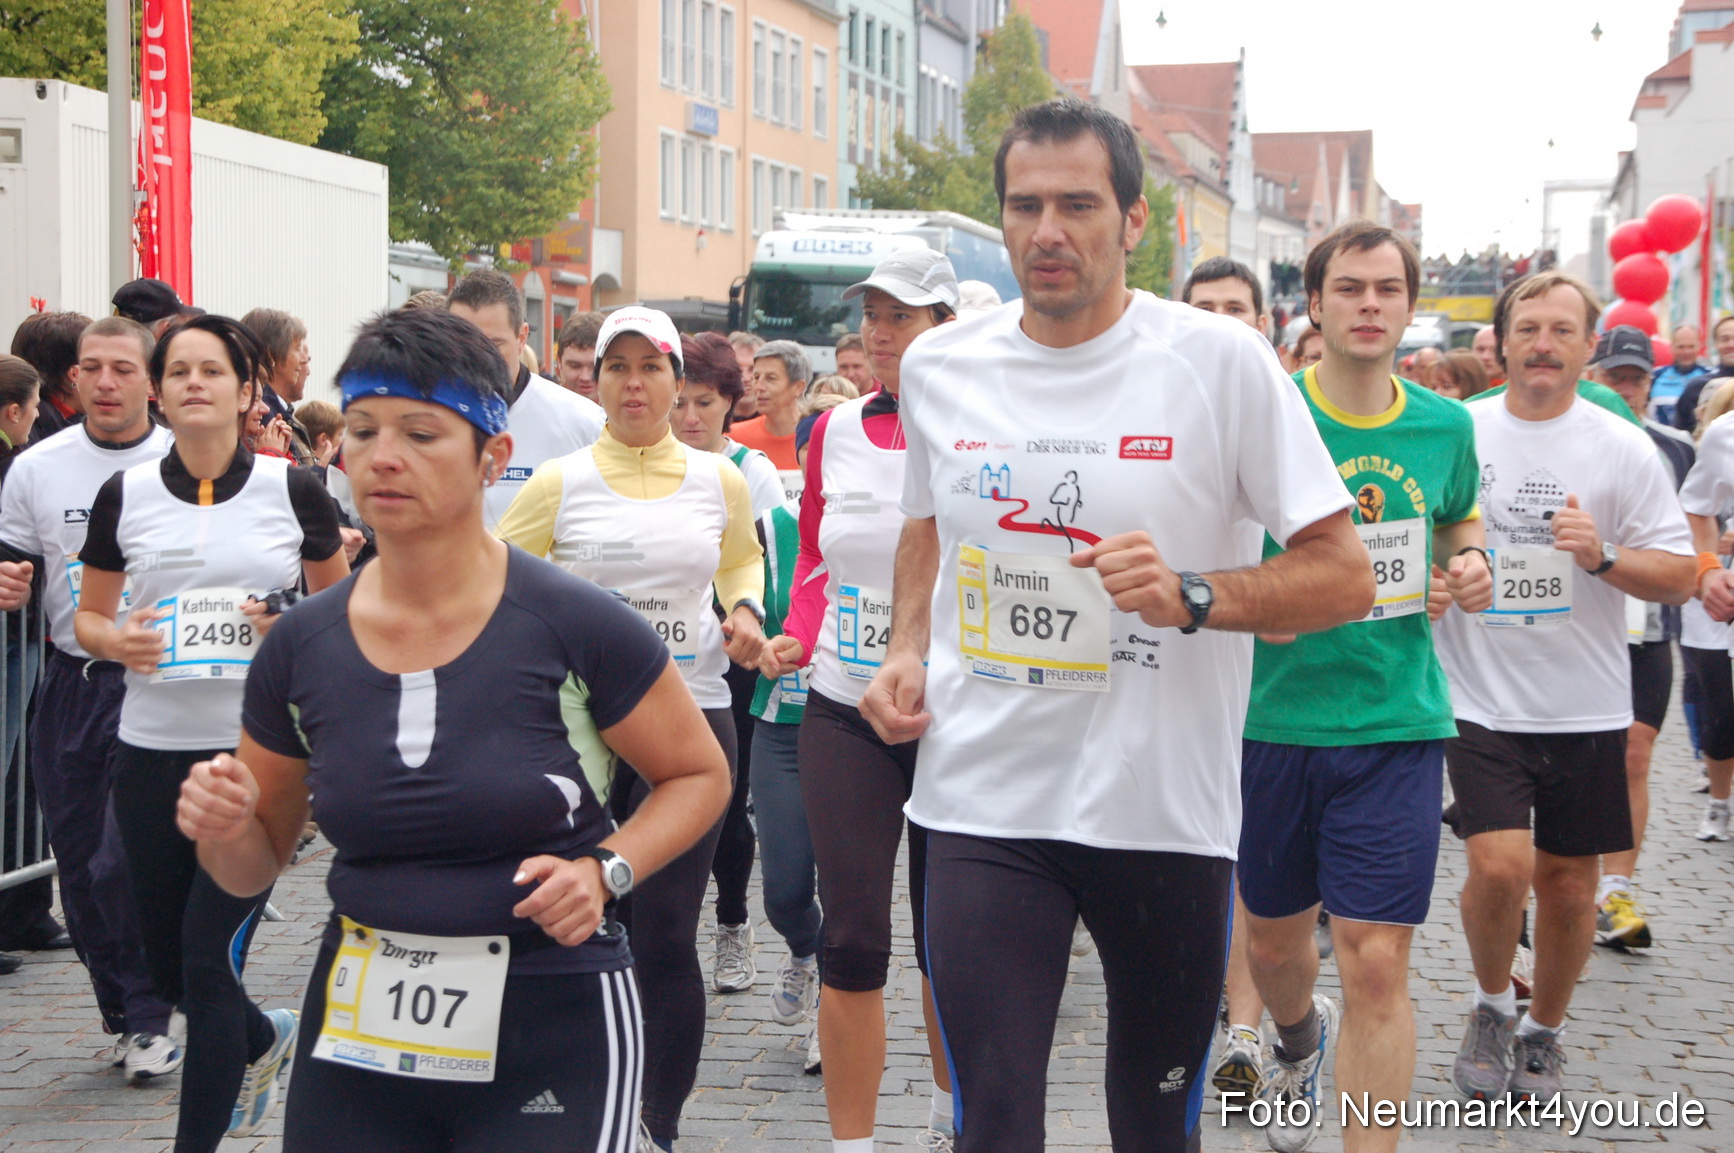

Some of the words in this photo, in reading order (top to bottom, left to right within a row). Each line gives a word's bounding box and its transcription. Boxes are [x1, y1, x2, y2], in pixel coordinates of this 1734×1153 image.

[793, 239, 872, 254] BOCK
[1337, 456, 1404, 481] WORLD
[1402, 477, 1426, 515] CUP
[1493, 523, 1551, 534] Neumarkt
[1501, 556, 1526, 569] Uwe
[994, 564, 1049, 592] Armin
[1503, 577, 1562, 599] 2058
[182, 598, 233, 615] Kathrin
[649, 621, 686, 643] 96
[1010, 604, 1078, 642] 687
[184, 622, 253, 647] 2498
[973, 660, 1007, 675] BOCK
[1045, 669, 1107, 683] PFLEIDERER
[388, 980, 468, 1028] 107
[419, 1054, 490, 1072] PFLEIDERER
[521, 1104, 564, 1113] adidas
